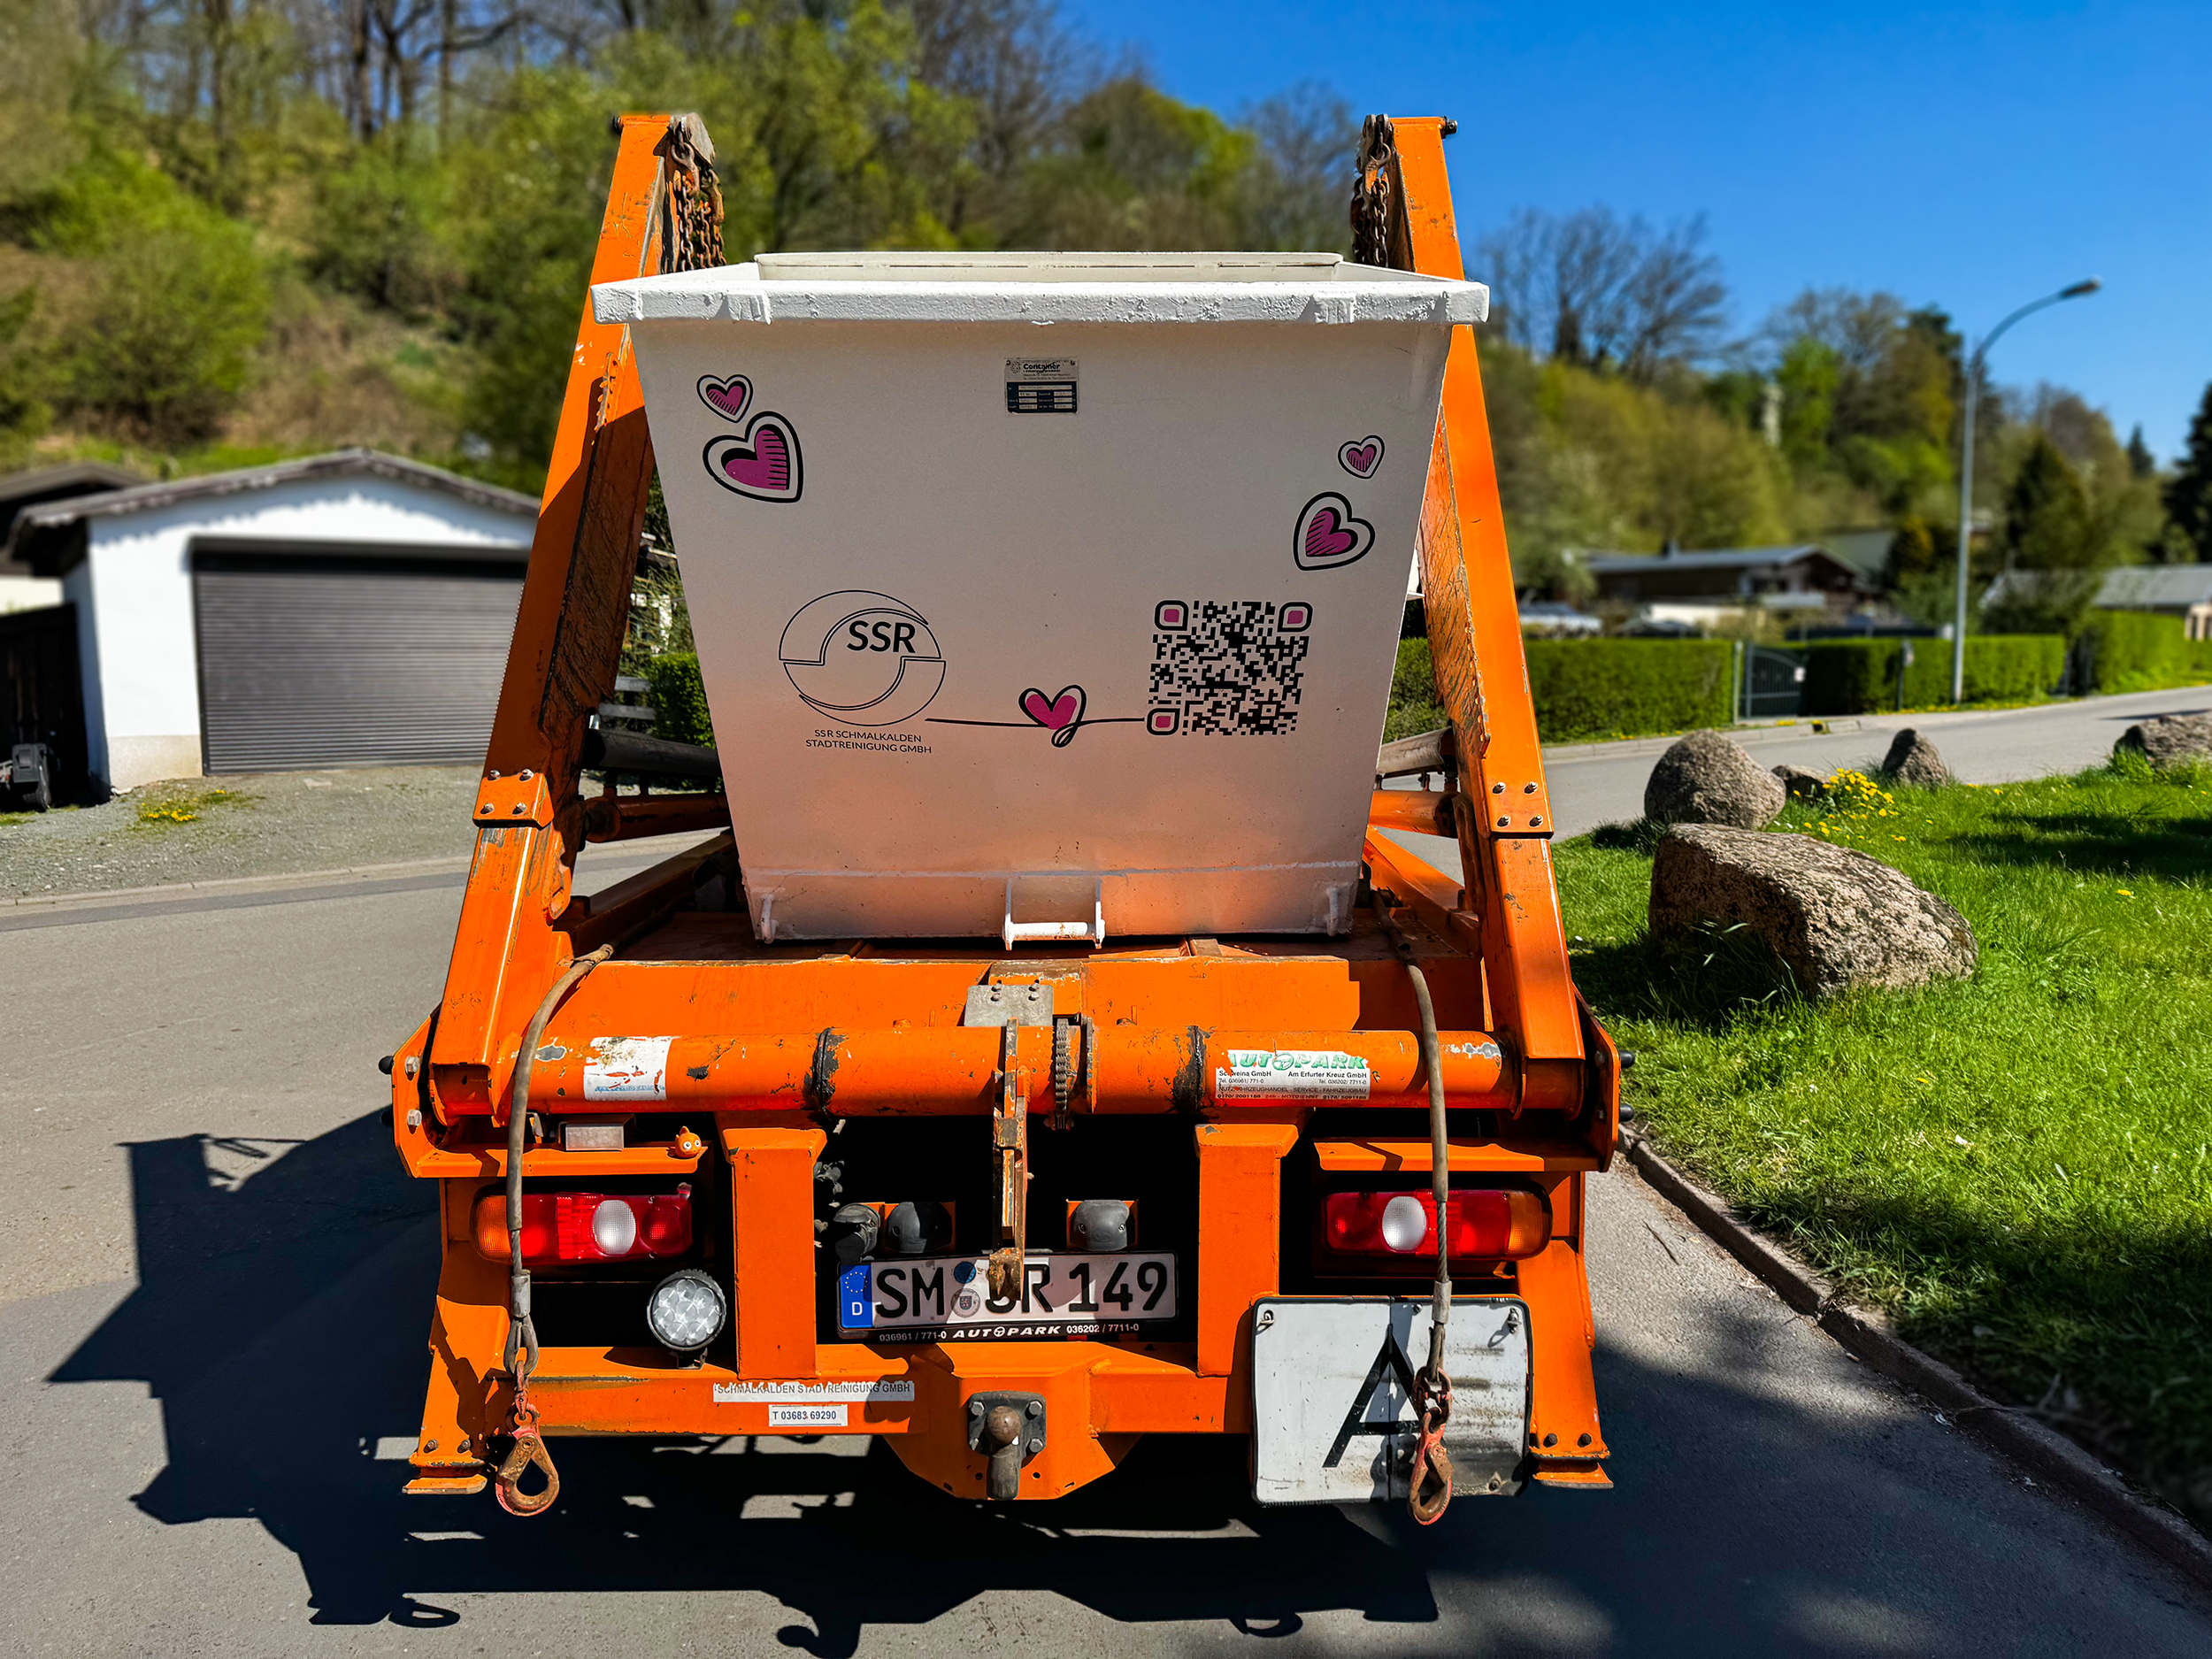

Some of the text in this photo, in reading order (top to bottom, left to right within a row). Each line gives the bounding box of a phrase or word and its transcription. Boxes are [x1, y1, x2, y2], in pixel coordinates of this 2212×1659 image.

[847, 620, 916, 653] SSR
[814, 729, 922, 742] SSR SCHMALKALDEN
[805, 739, 932, 754] STADTREINIGUNG GMBH
[874, 1266, 945, 1318] SM
[1069, 1262, 1168, 1312] 149
[851, 1302, 863, 1316] D
[920, 1330, 948, 1340] 771-0
[1108, 1323, 1140, 1333] 7711-0
[797, 1384, 879, 1394] SADREINIGUNG
[882, 1383, 910, 1393] GMBH
[772, 1410, 837, 1420] T 03683 69290
